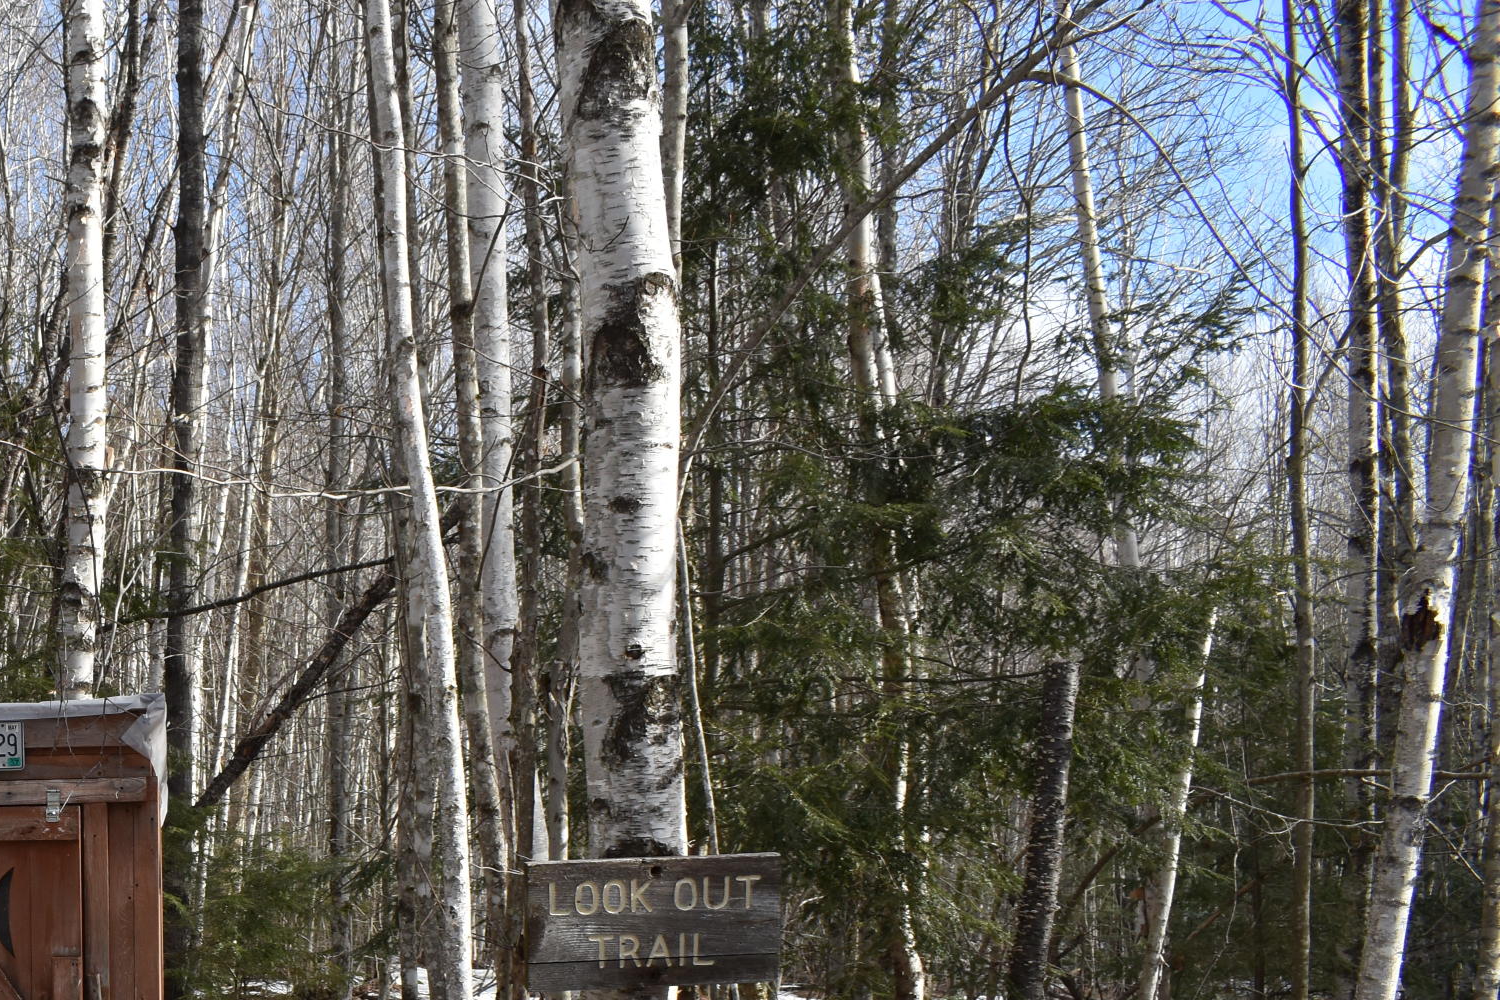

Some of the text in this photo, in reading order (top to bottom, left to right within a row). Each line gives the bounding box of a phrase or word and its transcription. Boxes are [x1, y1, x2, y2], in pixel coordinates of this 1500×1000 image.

[548, 874, 762, 916] LOOK OUT
[588, 932, 716, 969] TRAIL
